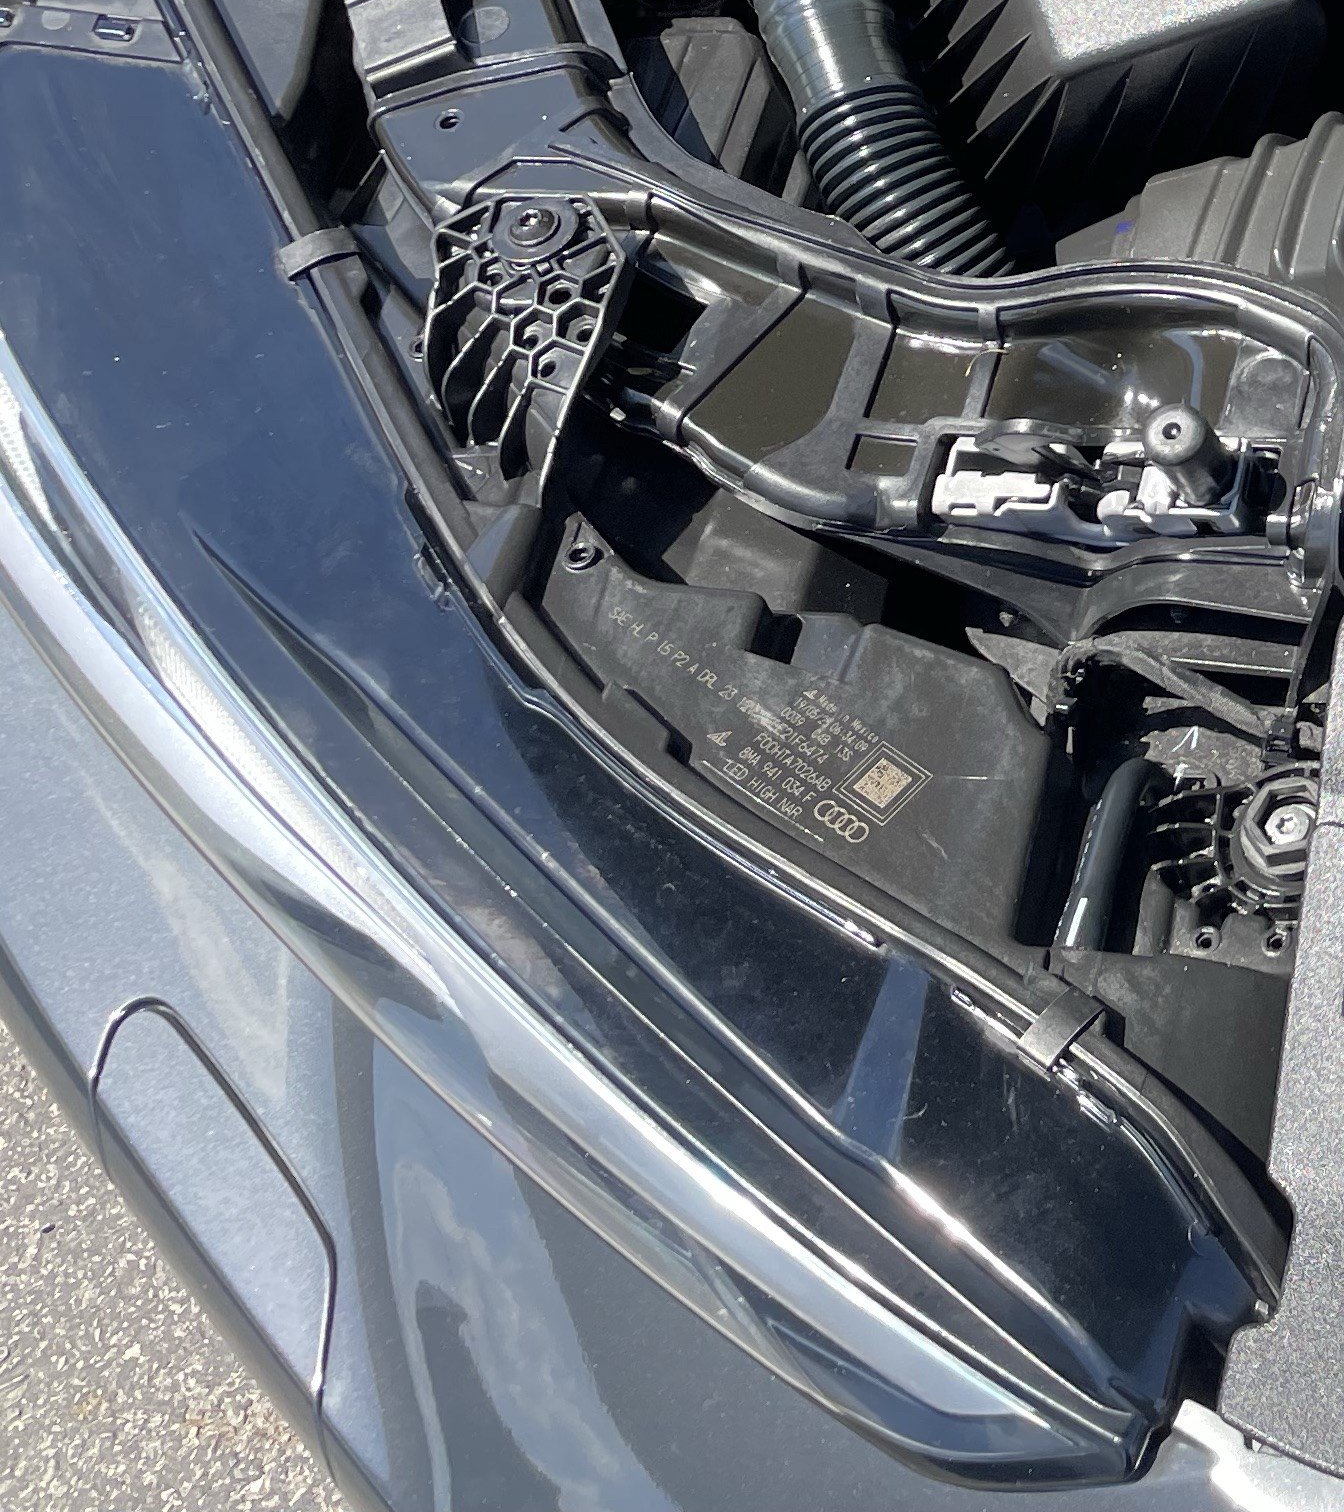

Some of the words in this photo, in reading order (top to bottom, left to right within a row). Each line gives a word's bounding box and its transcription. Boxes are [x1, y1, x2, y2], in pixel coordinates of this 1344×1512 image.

[644, 631, 659, 642] P
[670, 650, 690, 668] P2
[686, 662, 700, 675] A
[723, 758, 749, 781] LED
[747, 776, 780, 803] HIGH
[777, 797, 803, 820] NAR
